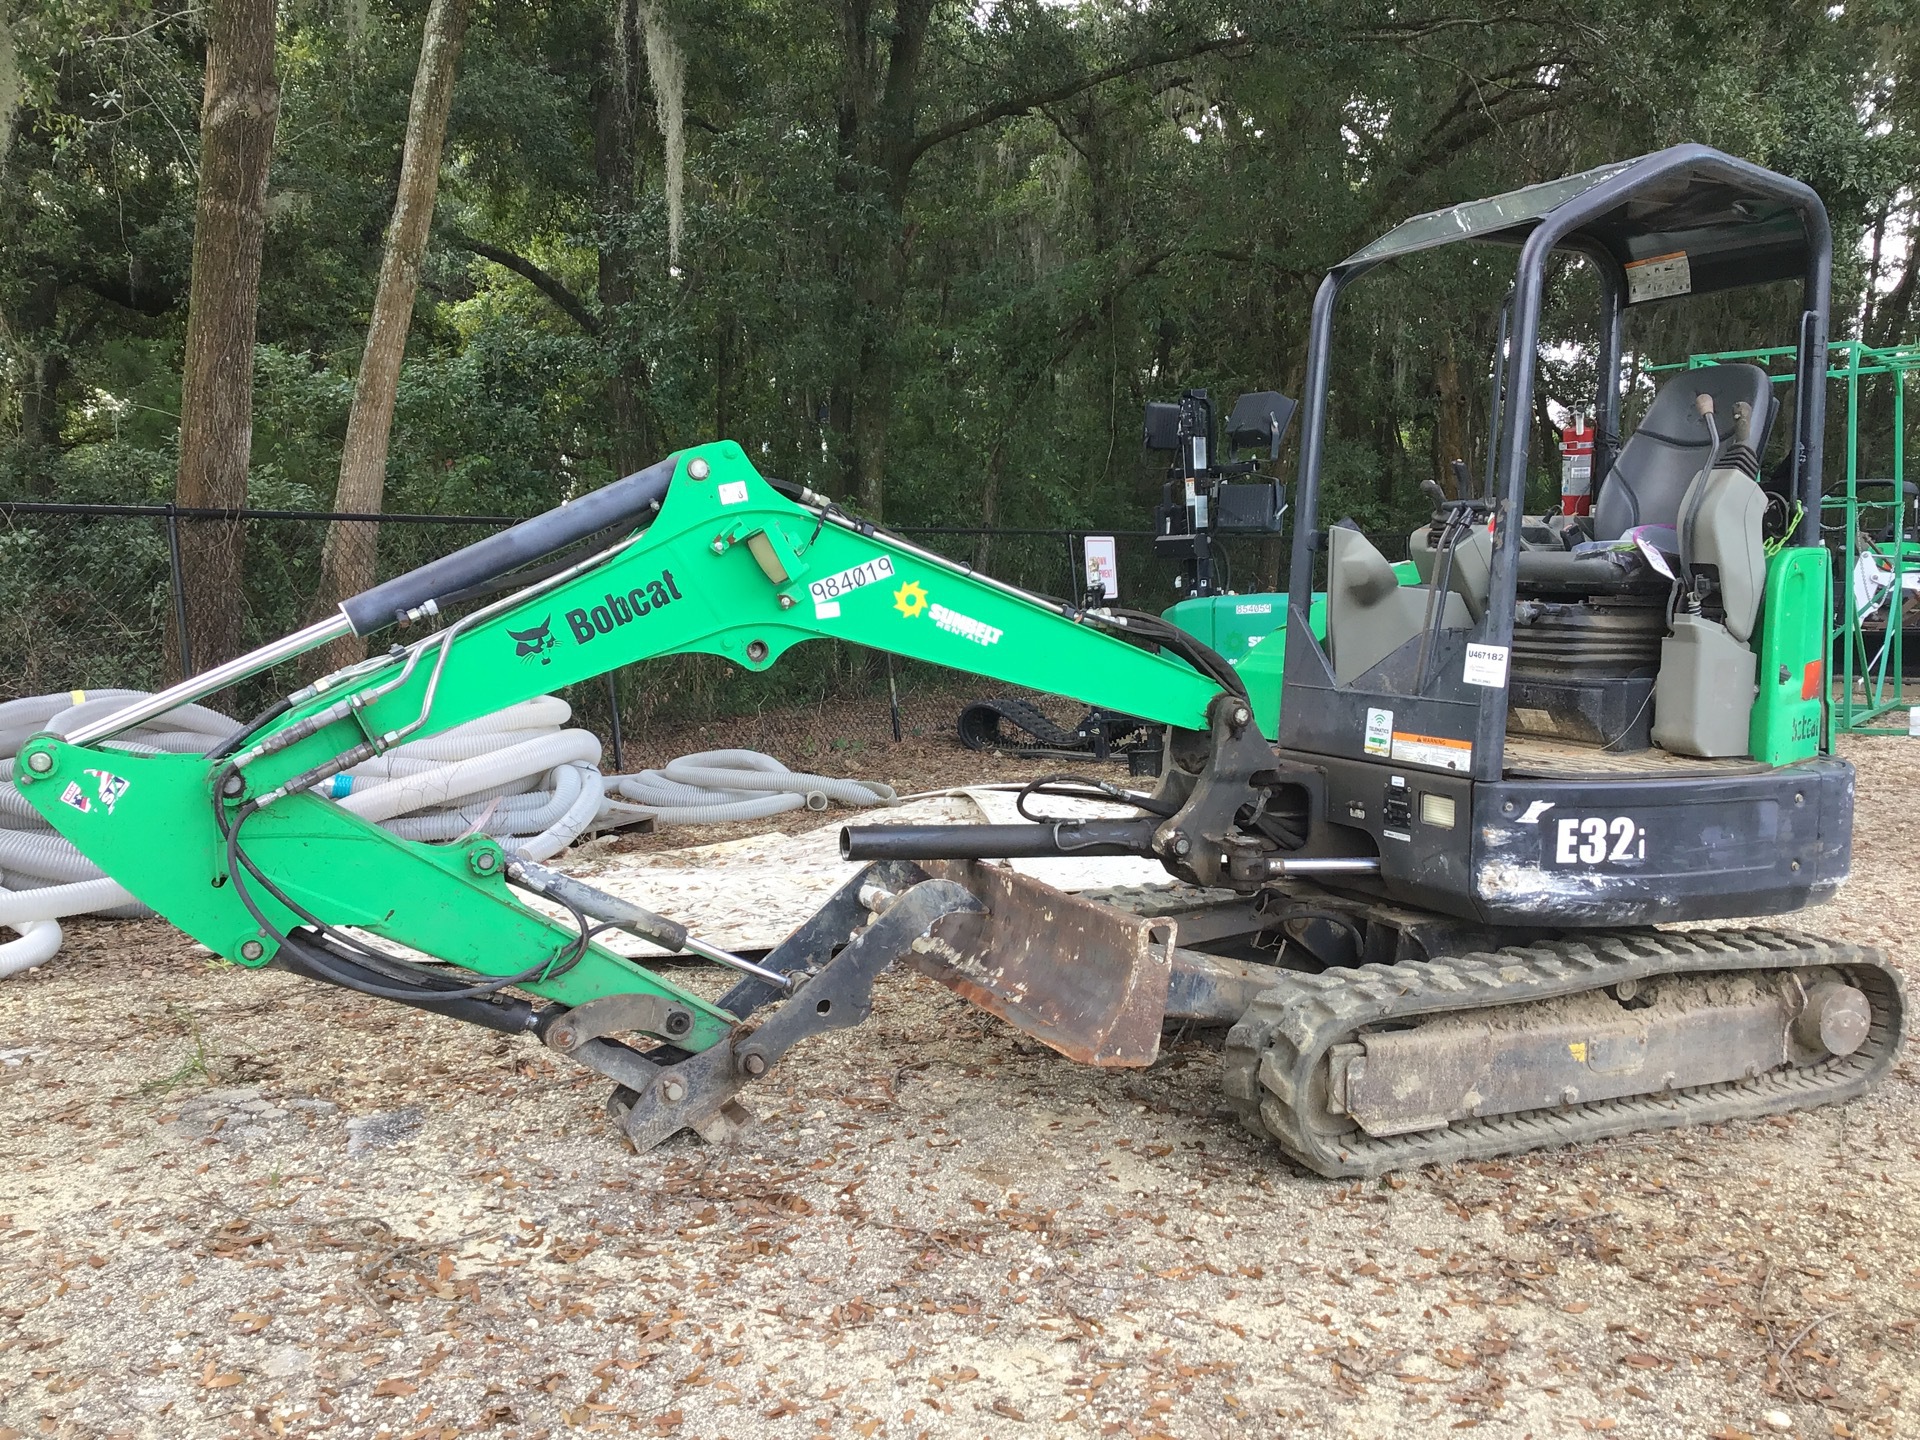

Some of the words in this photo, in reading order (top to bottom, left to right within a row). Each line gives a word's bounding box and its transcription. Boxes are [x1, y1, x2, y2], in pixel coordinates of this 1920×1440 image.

[811, 556, 894, 600] 984019
[565, 569, 683, 646] Bobcat
[928, 603, 1004, 645] SUNBELT
[935, 620, 988, 647] RENTALS
[1468, 650, 1504, 661] U467182
[1422, 737, 1446, 746] WARNING
[1556, 816, 1645, 864] E32i
